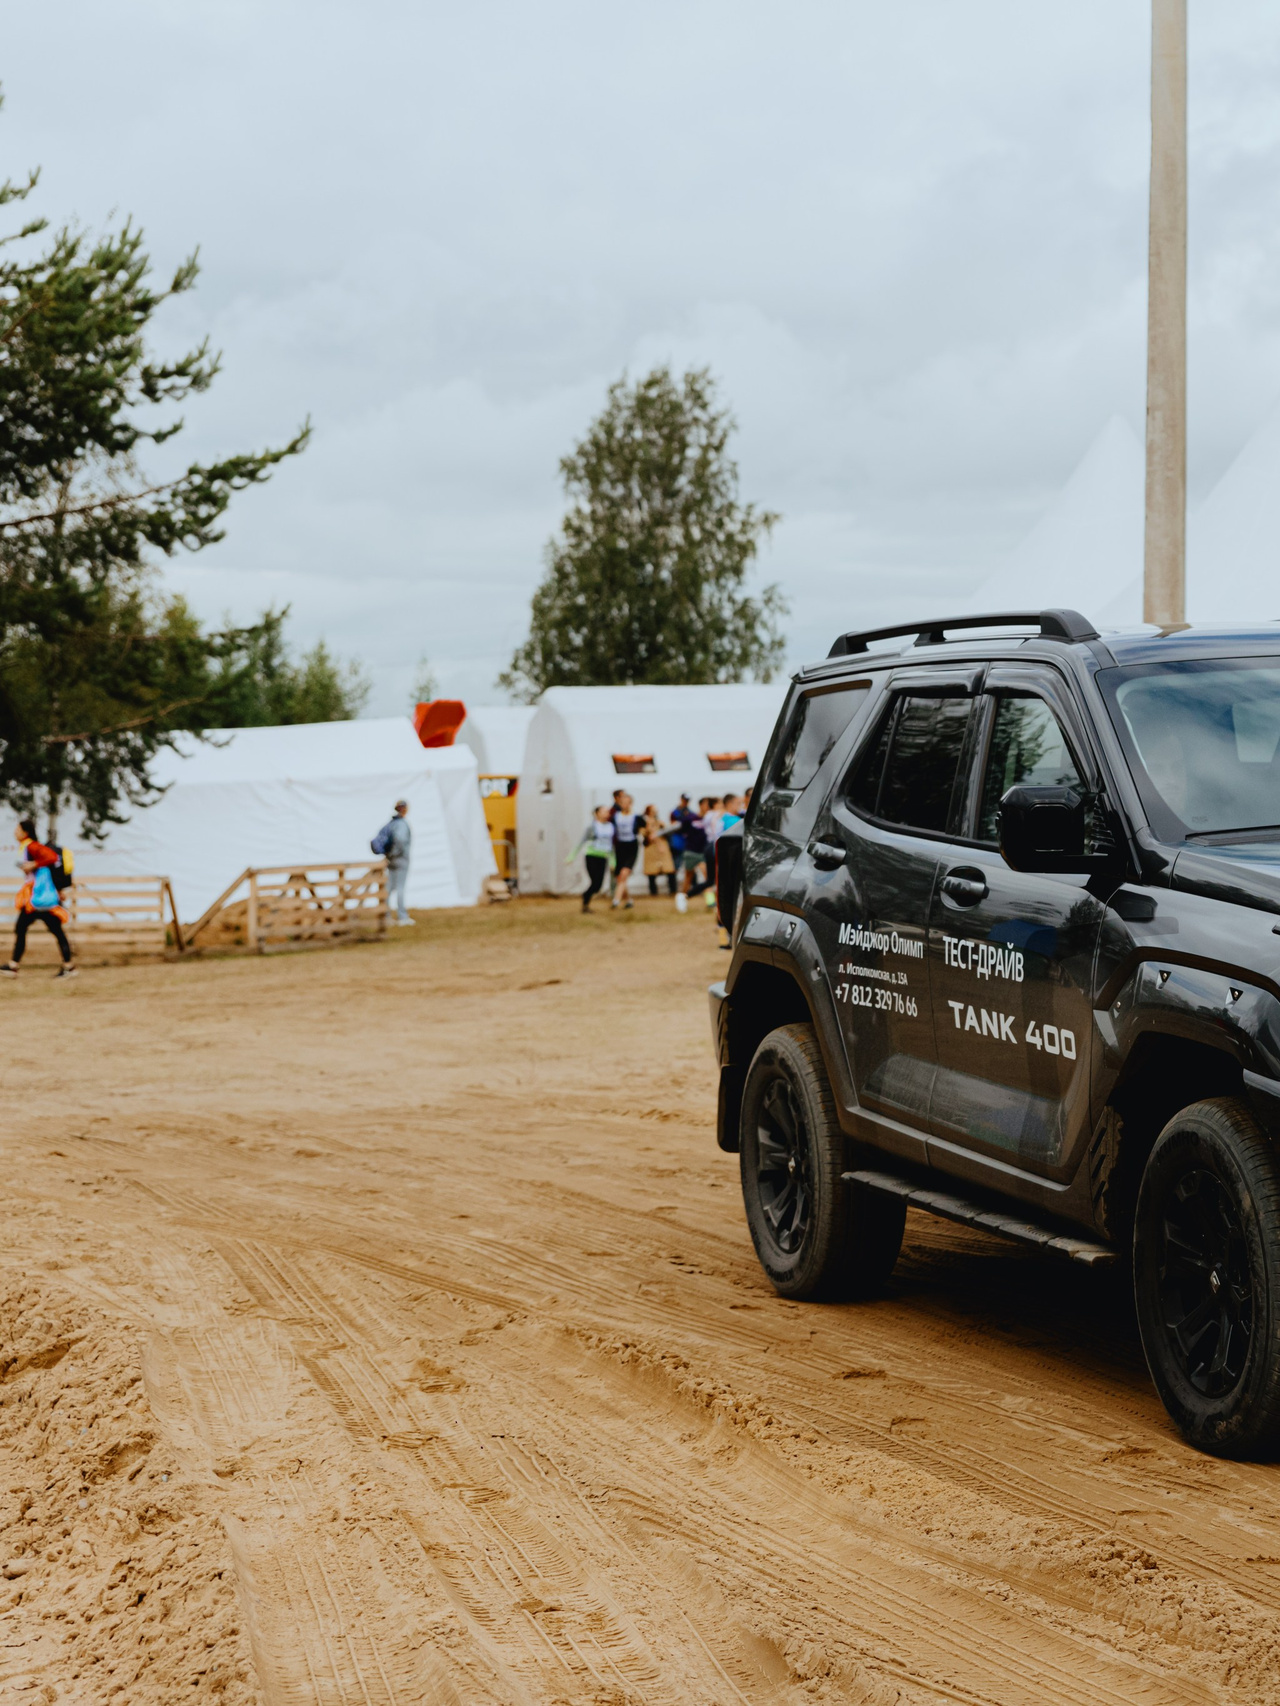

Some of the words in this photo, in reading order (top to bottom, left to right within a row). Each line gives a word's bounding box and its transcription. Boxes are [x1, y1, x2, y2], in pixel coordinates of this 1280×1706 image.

[838, 922, 889, 956] Мэйджор
[891, 931, 924, 959] Олимп
[942, 935, 1025, 983] ТЕСТ-ДРАЙВ
[835, 982, 850, 1003] +7
[851, 984, 873, 1008] 812
[874, 988, 893, 1011] 329
[892, 992, 905, 1015] 76
[905, 995, 918, 1018] 66
[947, 1000, 1018, 1045] TANK
[1025, 1020, 1077, 1061] 400
